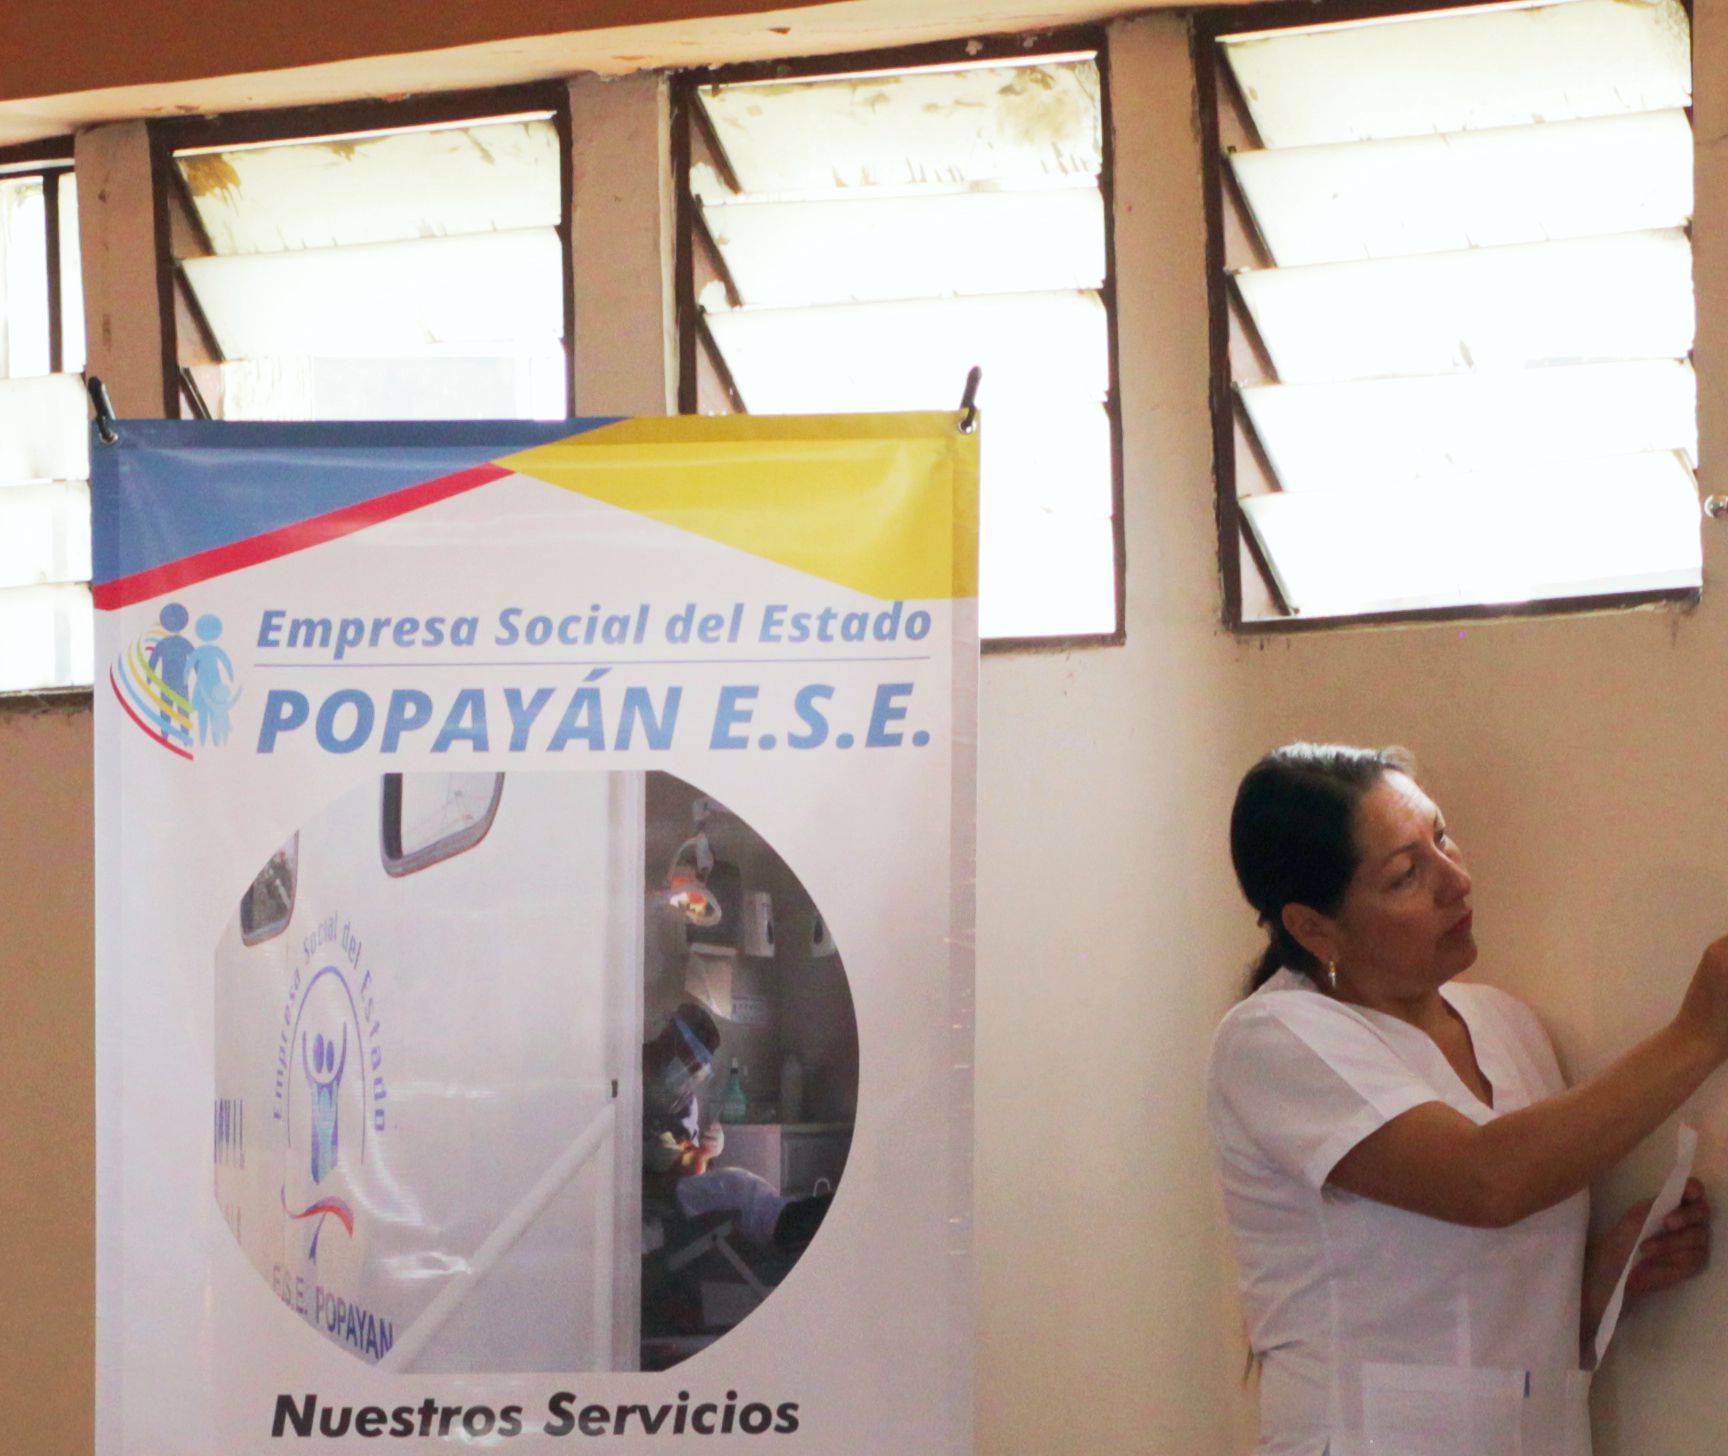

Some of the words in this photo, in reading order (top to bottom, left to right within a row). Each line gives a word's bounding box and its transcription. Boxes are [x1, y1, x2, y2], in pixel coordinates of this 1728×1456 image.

[256, 609, 479, 661] Empresa
[494, 603, 651, 647] Social
[664, 602, 745, 644] del
[759, 596, 932, 643] Estado
[255, 664, 683, 755] POPAYÁN
[709, 682, 931, 751] E.S.E.
[271, 1393, 523, 1439] Nuestros
[544, 1389, 800, 1437] Servicios
